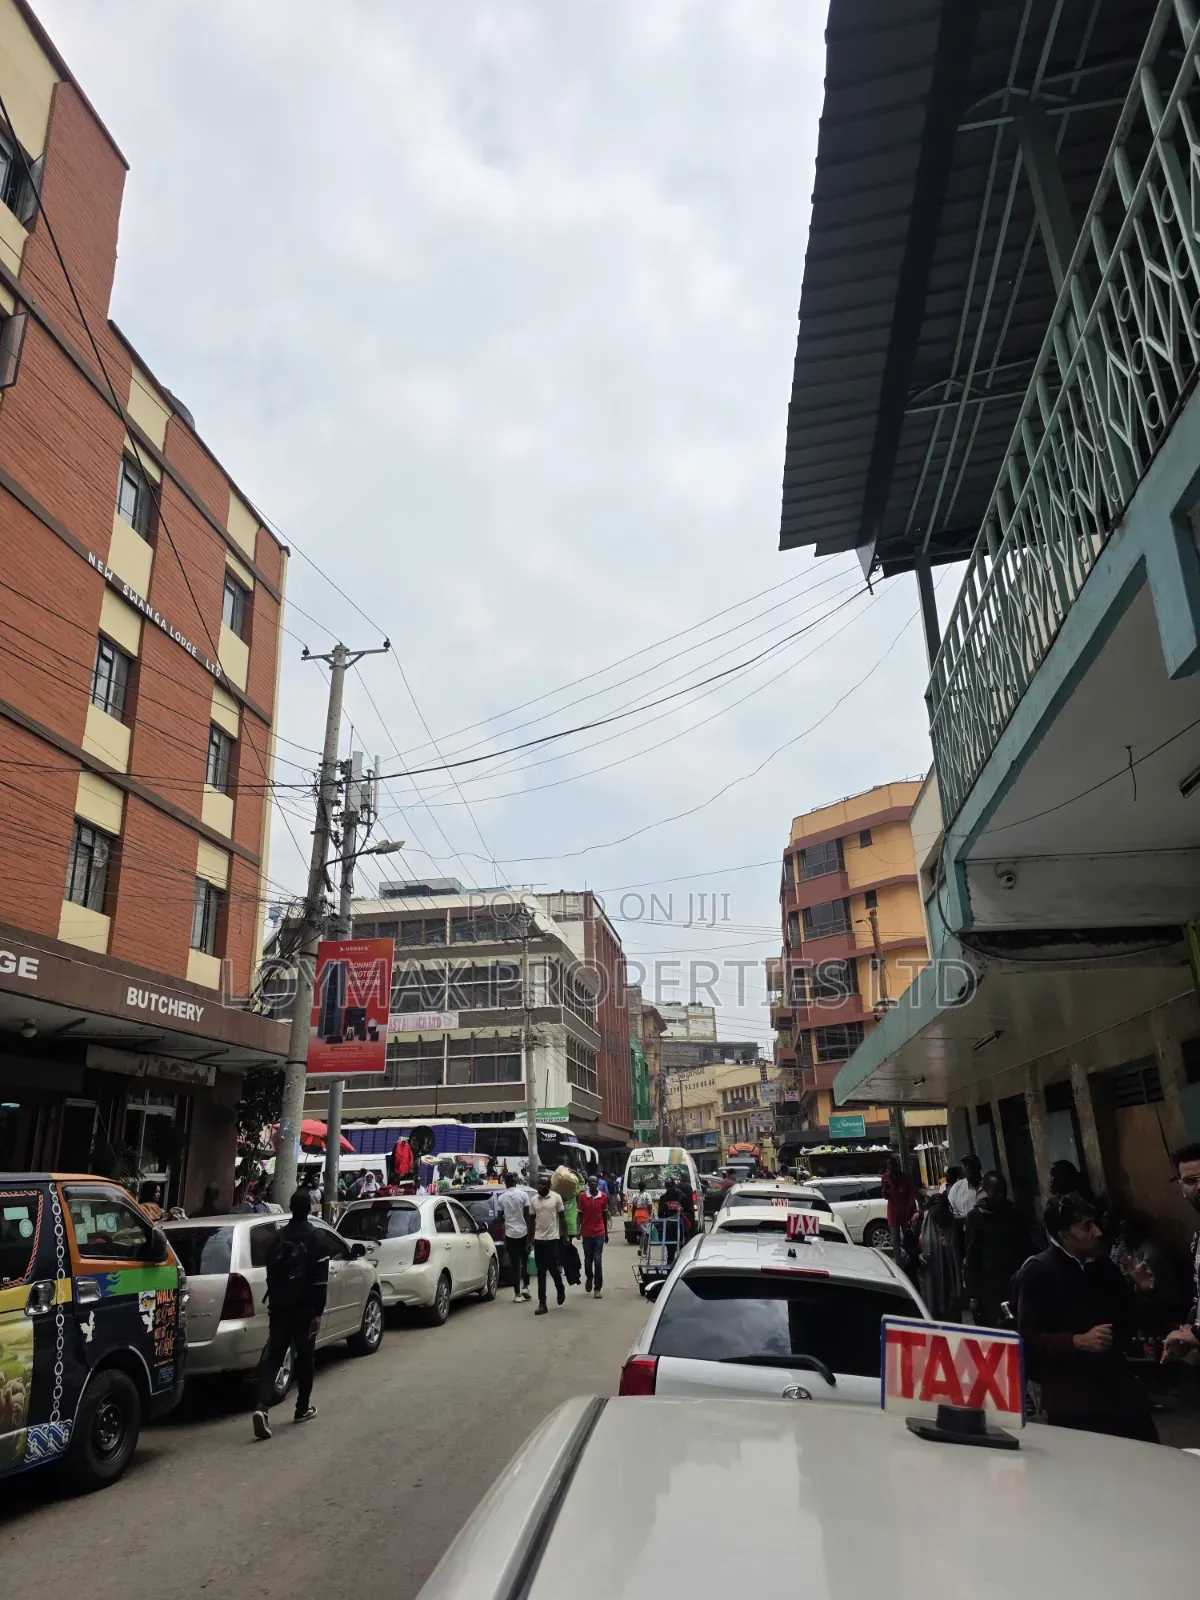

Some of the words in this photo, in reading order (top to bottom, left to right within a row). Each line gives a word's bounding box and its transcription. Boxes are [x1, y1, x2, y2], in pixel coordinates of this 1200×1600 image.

[88, 551, 113, 581] NEW
[122, 584, 167, 631] SWANGA
[169, 626, 197, 657] LODGE
[205, 658, 221, 678] LTD
[126, 986, 204, 1023] BUTCHERY
[771, 1198, 789, 1207] TAXI
[787, 1213, 820, 1235] TAXI
[885, 1329, 1022, 1414] TAXI
